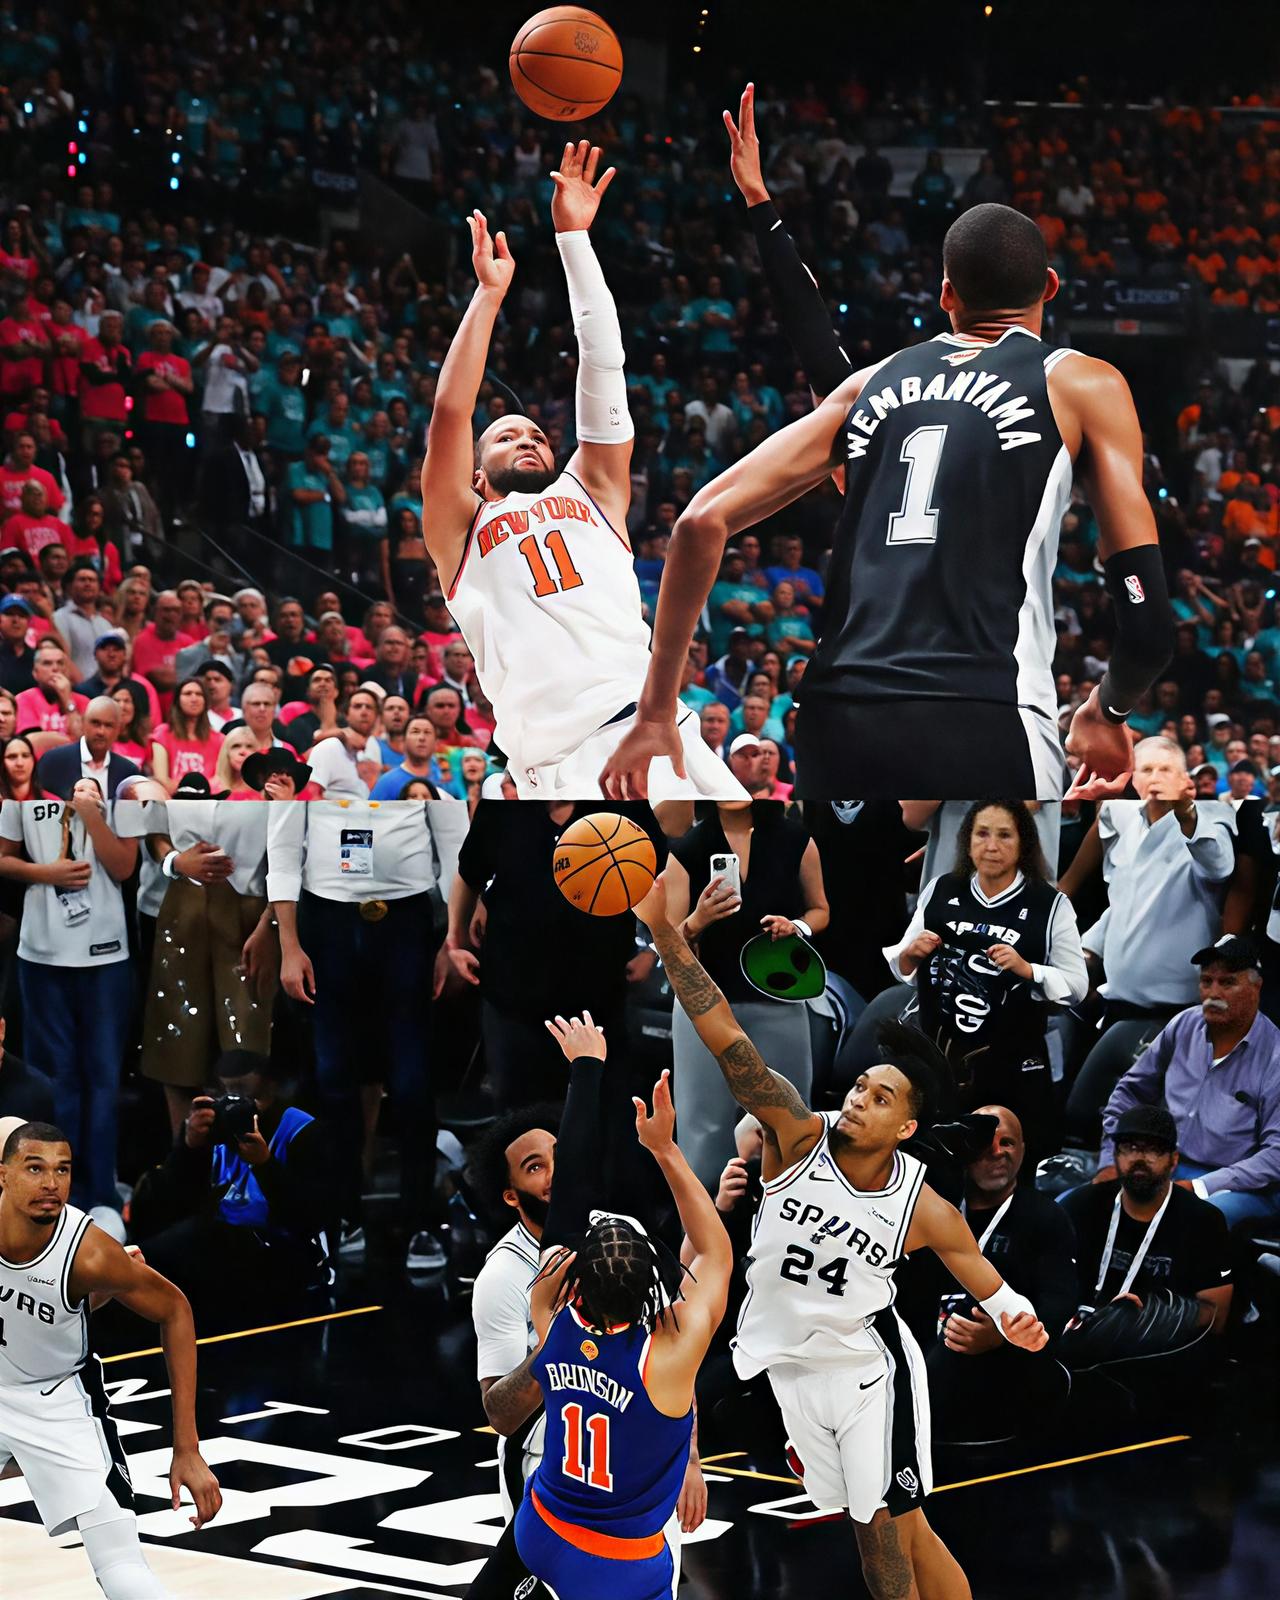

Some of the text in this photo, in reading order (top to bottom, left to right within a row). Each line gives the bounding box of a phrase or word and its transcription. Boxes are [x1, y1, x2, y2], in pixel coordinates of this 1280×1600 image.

[847, 371, 1042, 459] WEMBANYAMA
[886, 424, 948, 545] 1
[477, 510, 530, 559] NEW
[518, 530, 584, 597] 11
[780, 1243, 850, 1297] 24
[561, 1402, 613, 1493] 11
